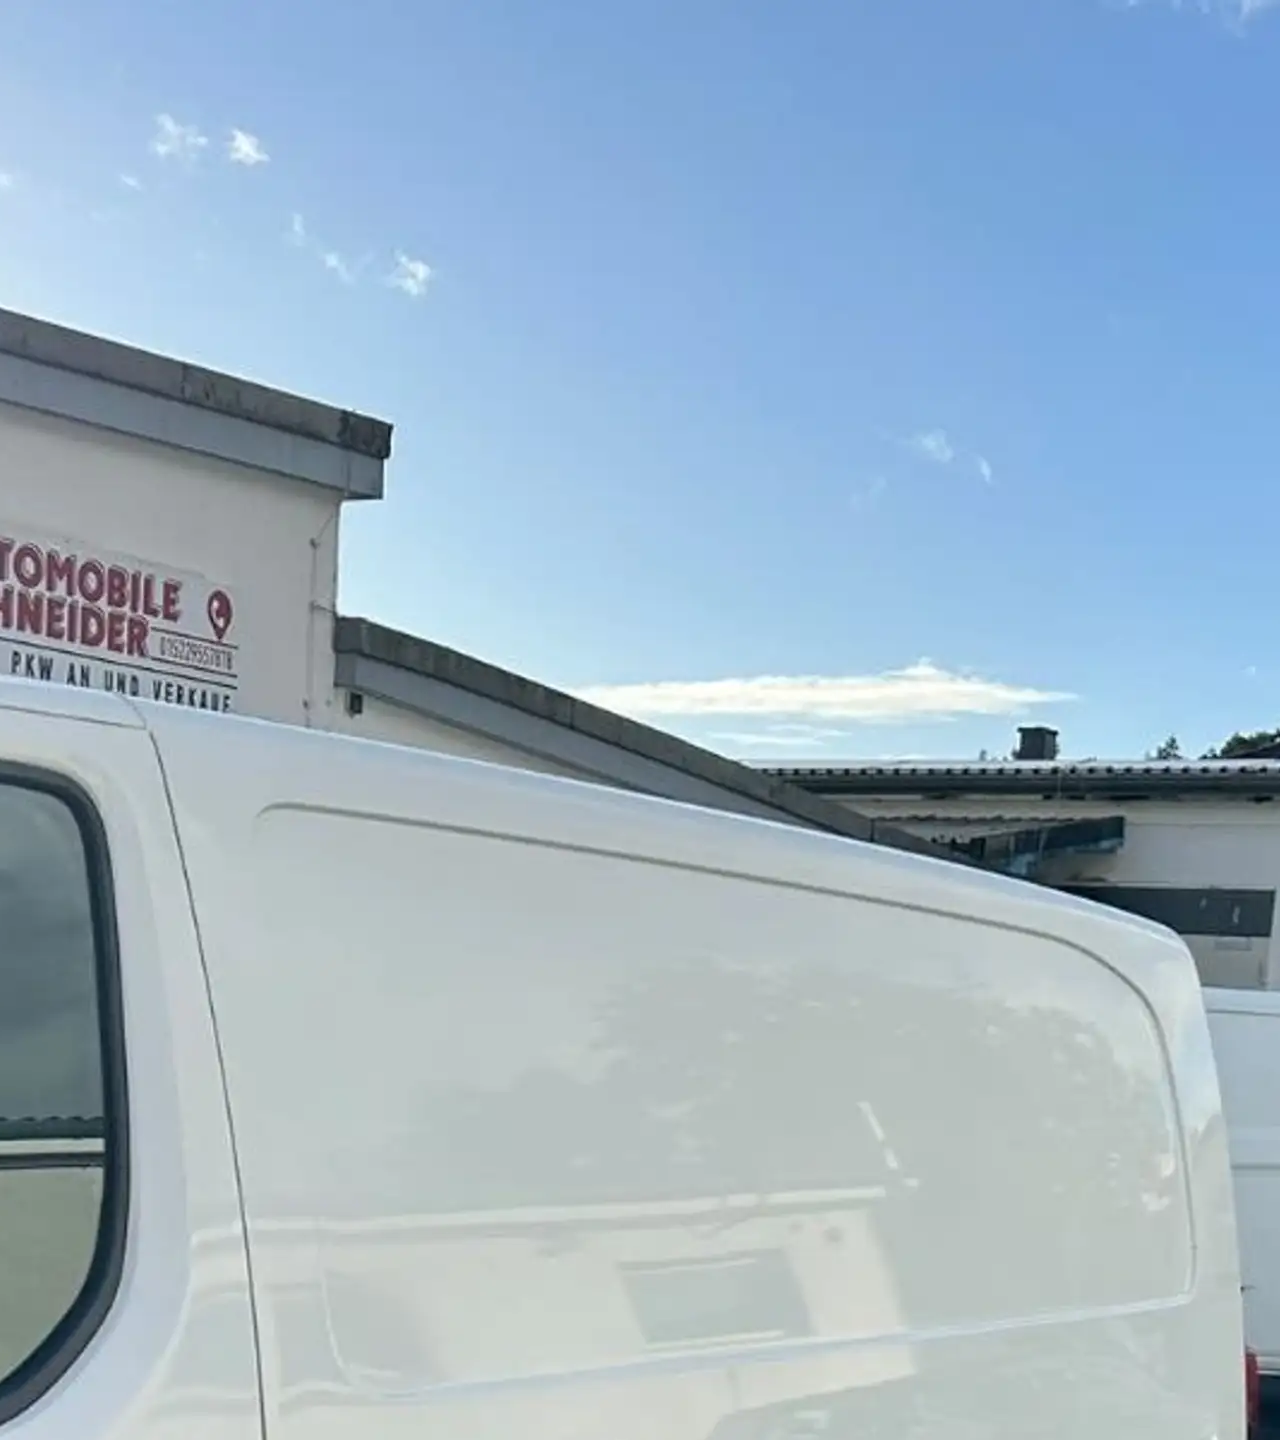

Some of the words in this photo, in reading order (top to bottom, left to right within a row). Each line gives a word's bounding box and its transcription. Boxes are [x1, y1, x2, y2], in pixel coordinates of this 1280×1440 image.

[10, 651, 54, 681] PKW
[66, 663, 90, 688] AN
[104, 669, 140, 697] UND
[152, 679, 231, 713] VERKAUF
